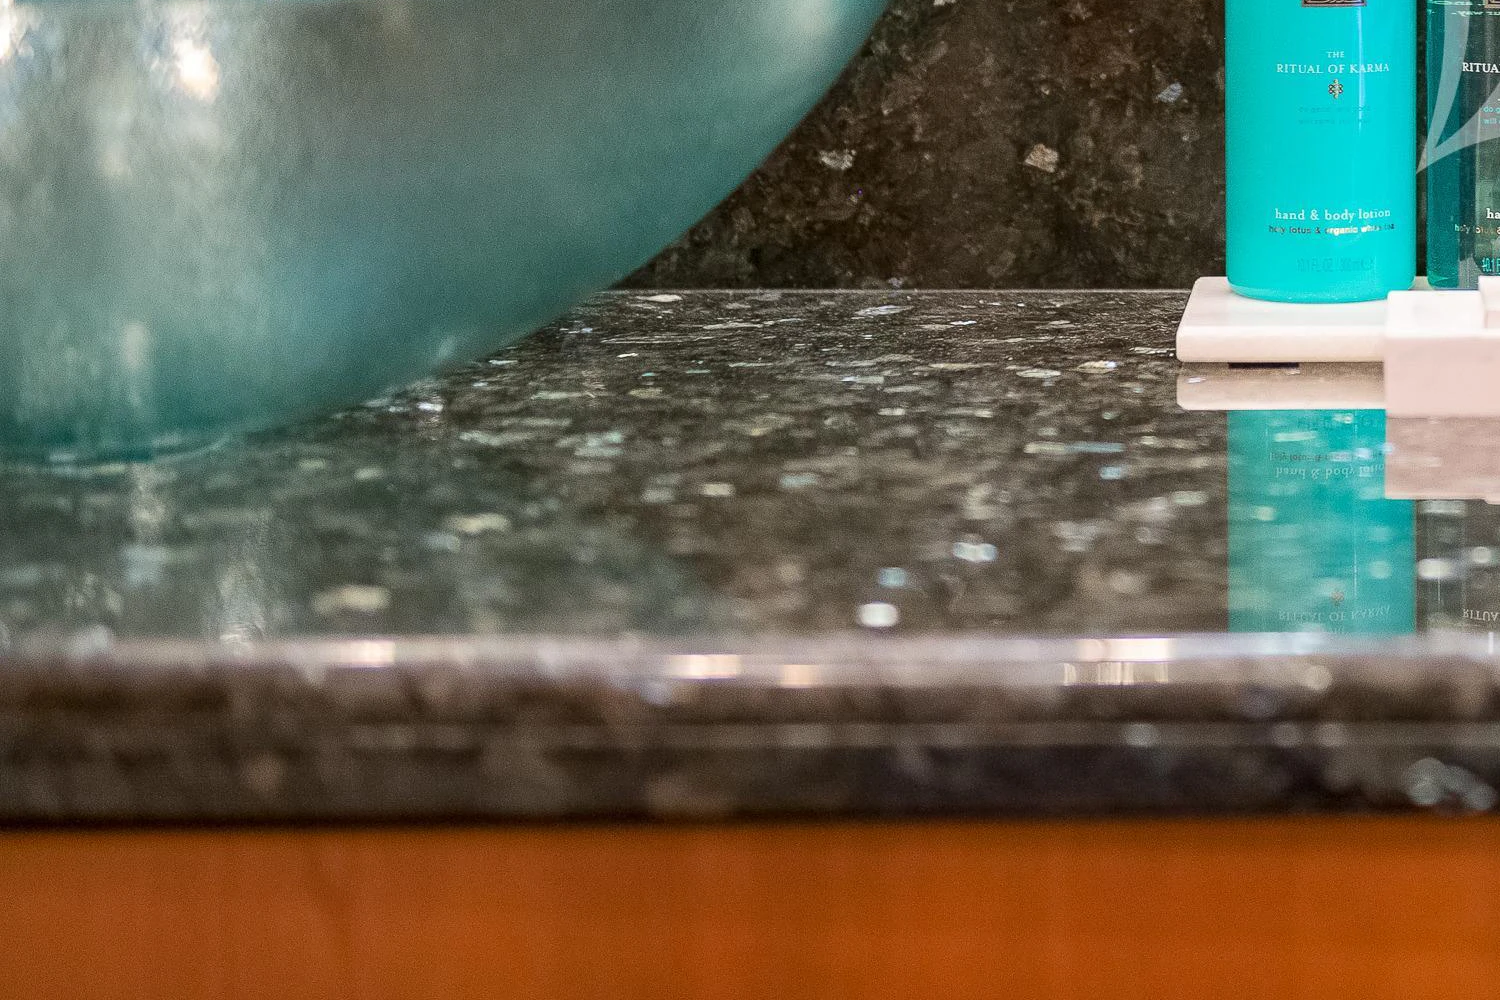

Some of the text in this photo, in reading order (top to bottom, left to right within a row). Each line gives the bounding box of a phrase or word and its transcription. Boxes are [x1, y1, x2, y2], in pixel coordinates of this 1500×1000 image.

[1276, 63, 1390, 74] RITUAL OF KARMA
[1275, 208, 1390, 223] hand & body lotion
